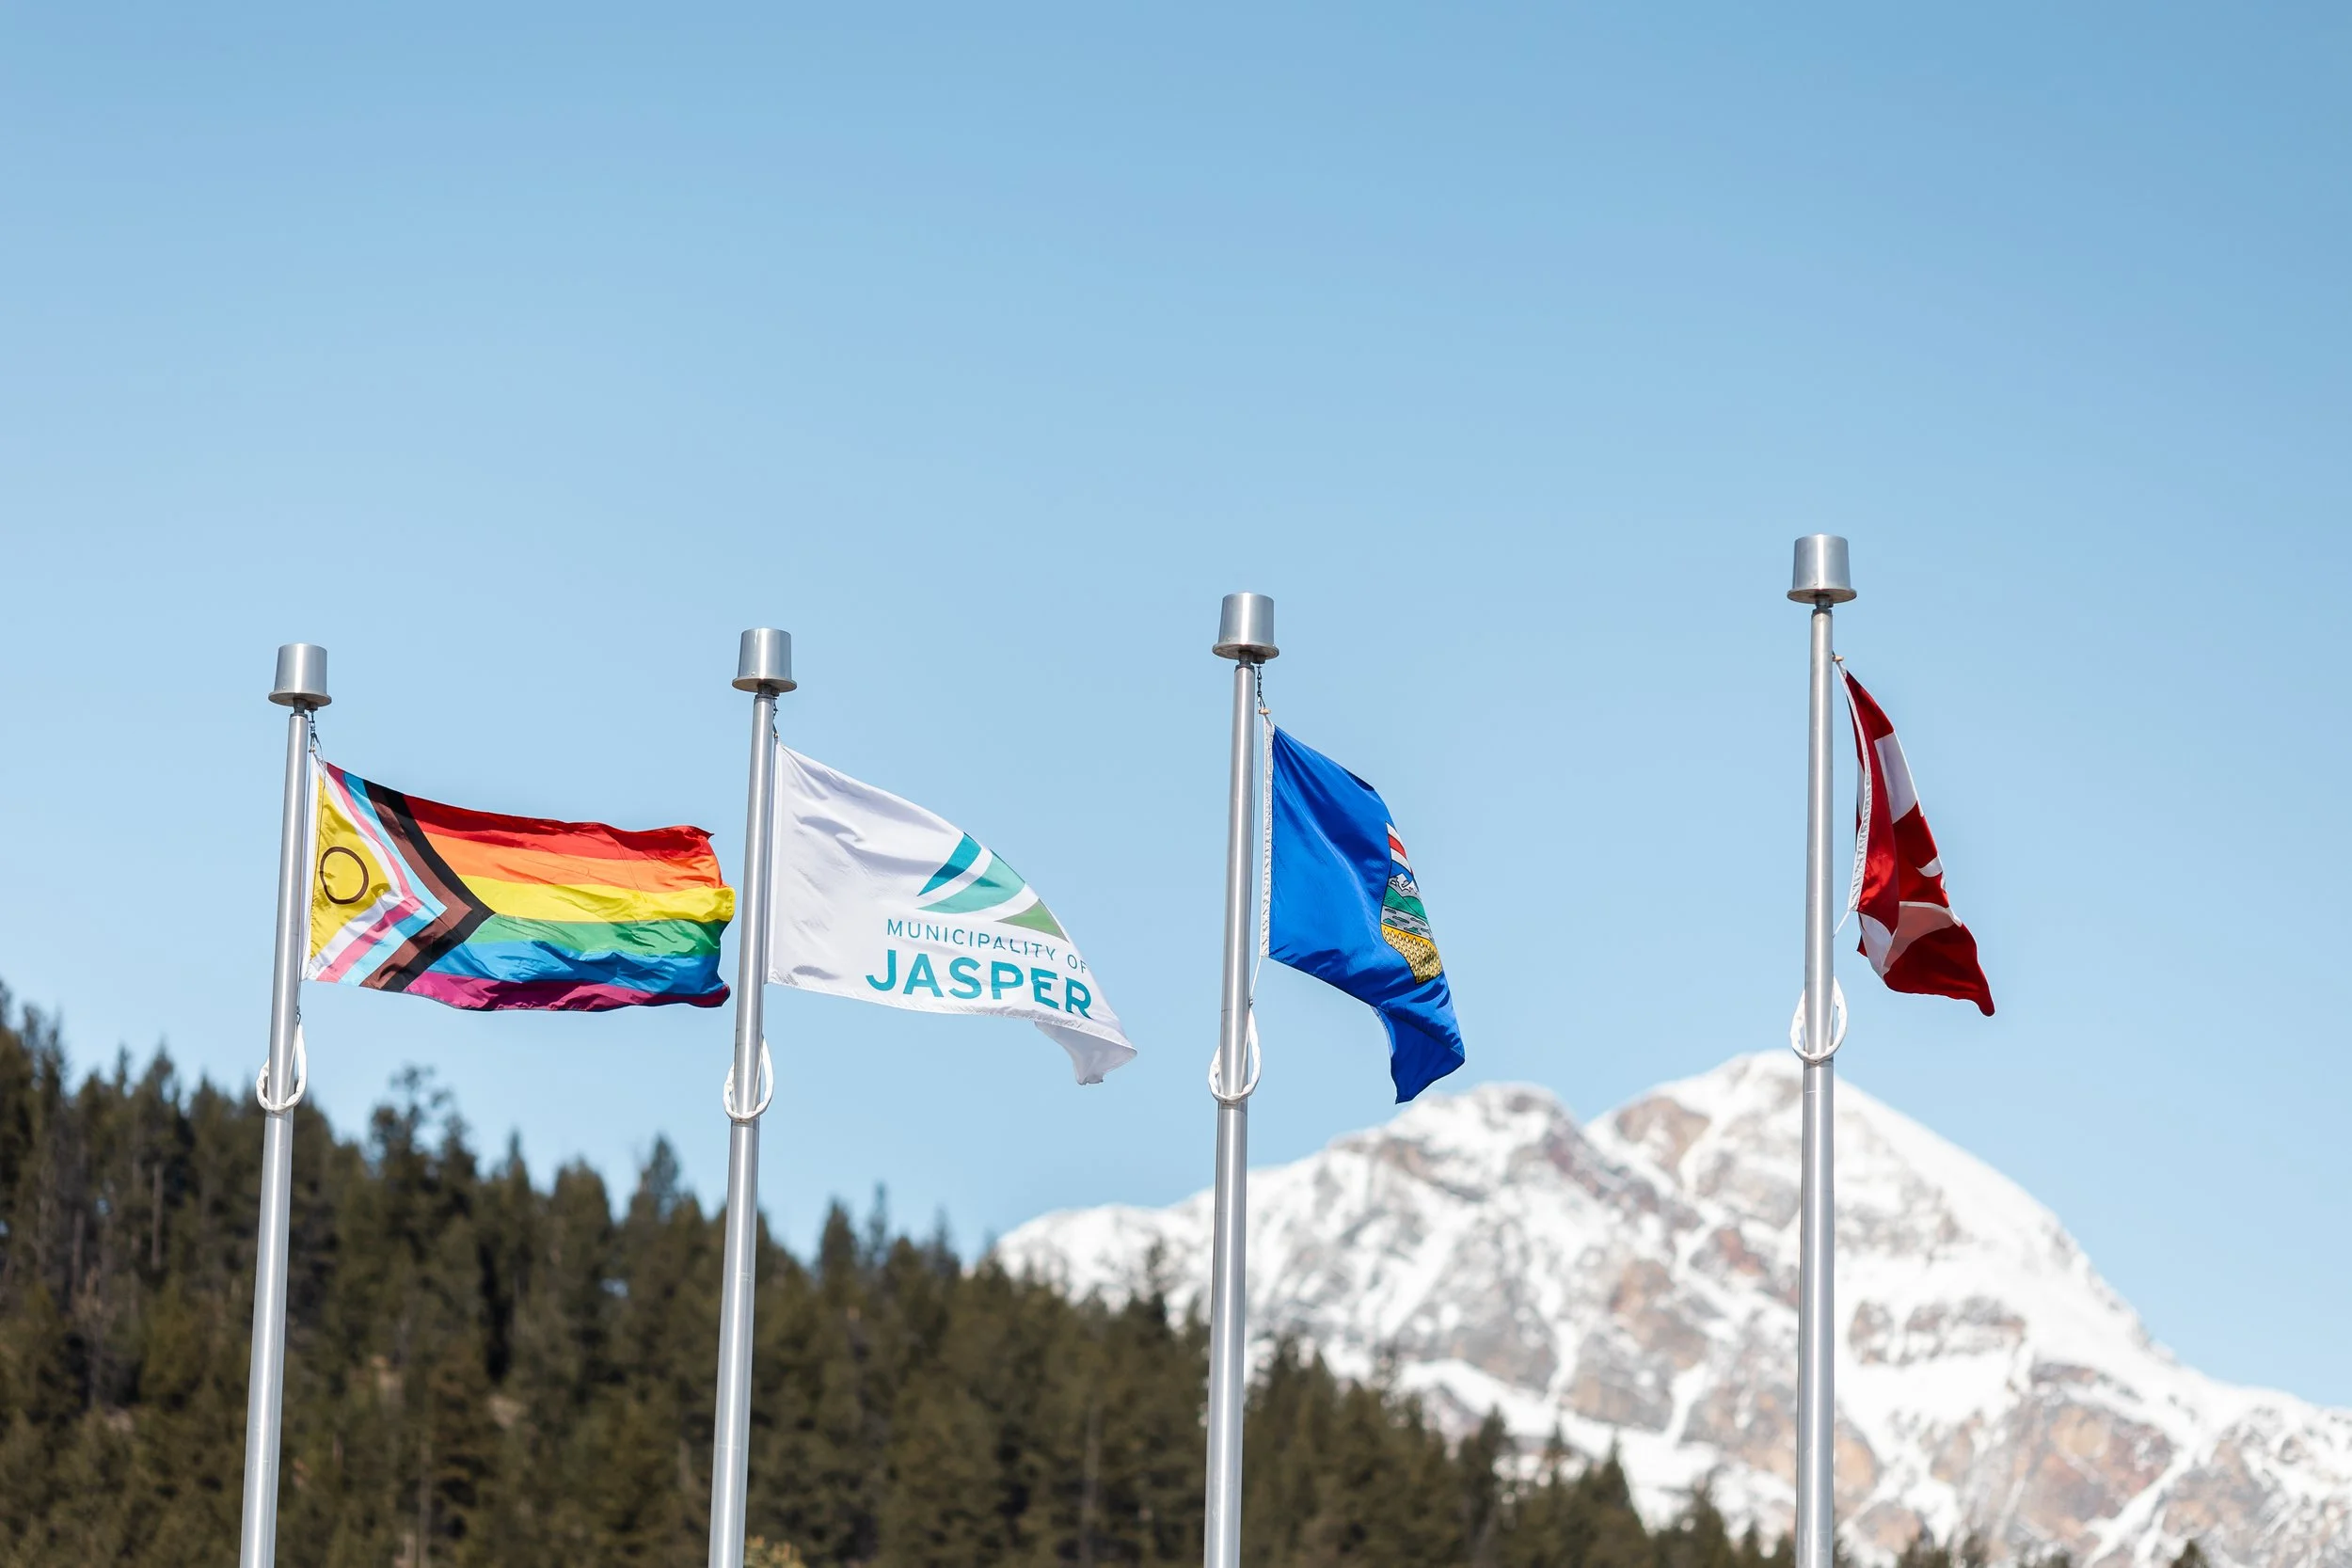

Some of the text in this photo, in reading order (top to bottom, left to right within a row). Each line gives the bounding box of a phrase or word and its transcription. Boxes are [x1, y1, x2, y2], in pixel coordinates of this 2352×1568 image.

[886, 918, 1088, 974] MUNICIPALITY OF
[865, 949, 1093, 1020] JASPER
